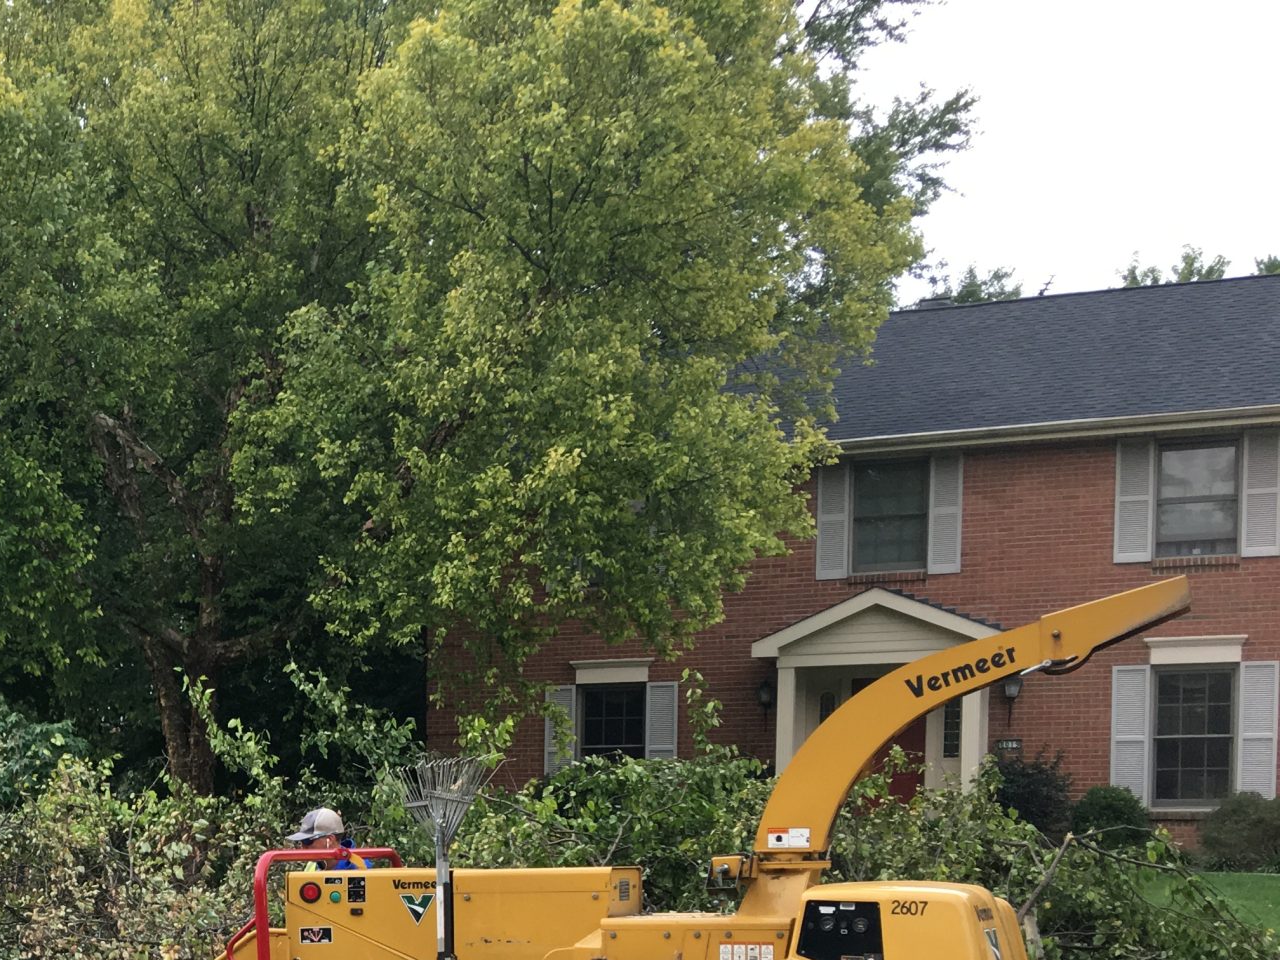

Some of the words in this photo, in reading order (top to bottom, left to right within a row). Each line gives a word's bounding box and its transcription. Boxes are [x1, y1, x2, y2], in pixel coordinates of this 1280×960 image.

[904, 646, 1016, 698] Vermeer
[392, 879, 437, 890] Vermee
[891, 900, 928, 916] 2607
